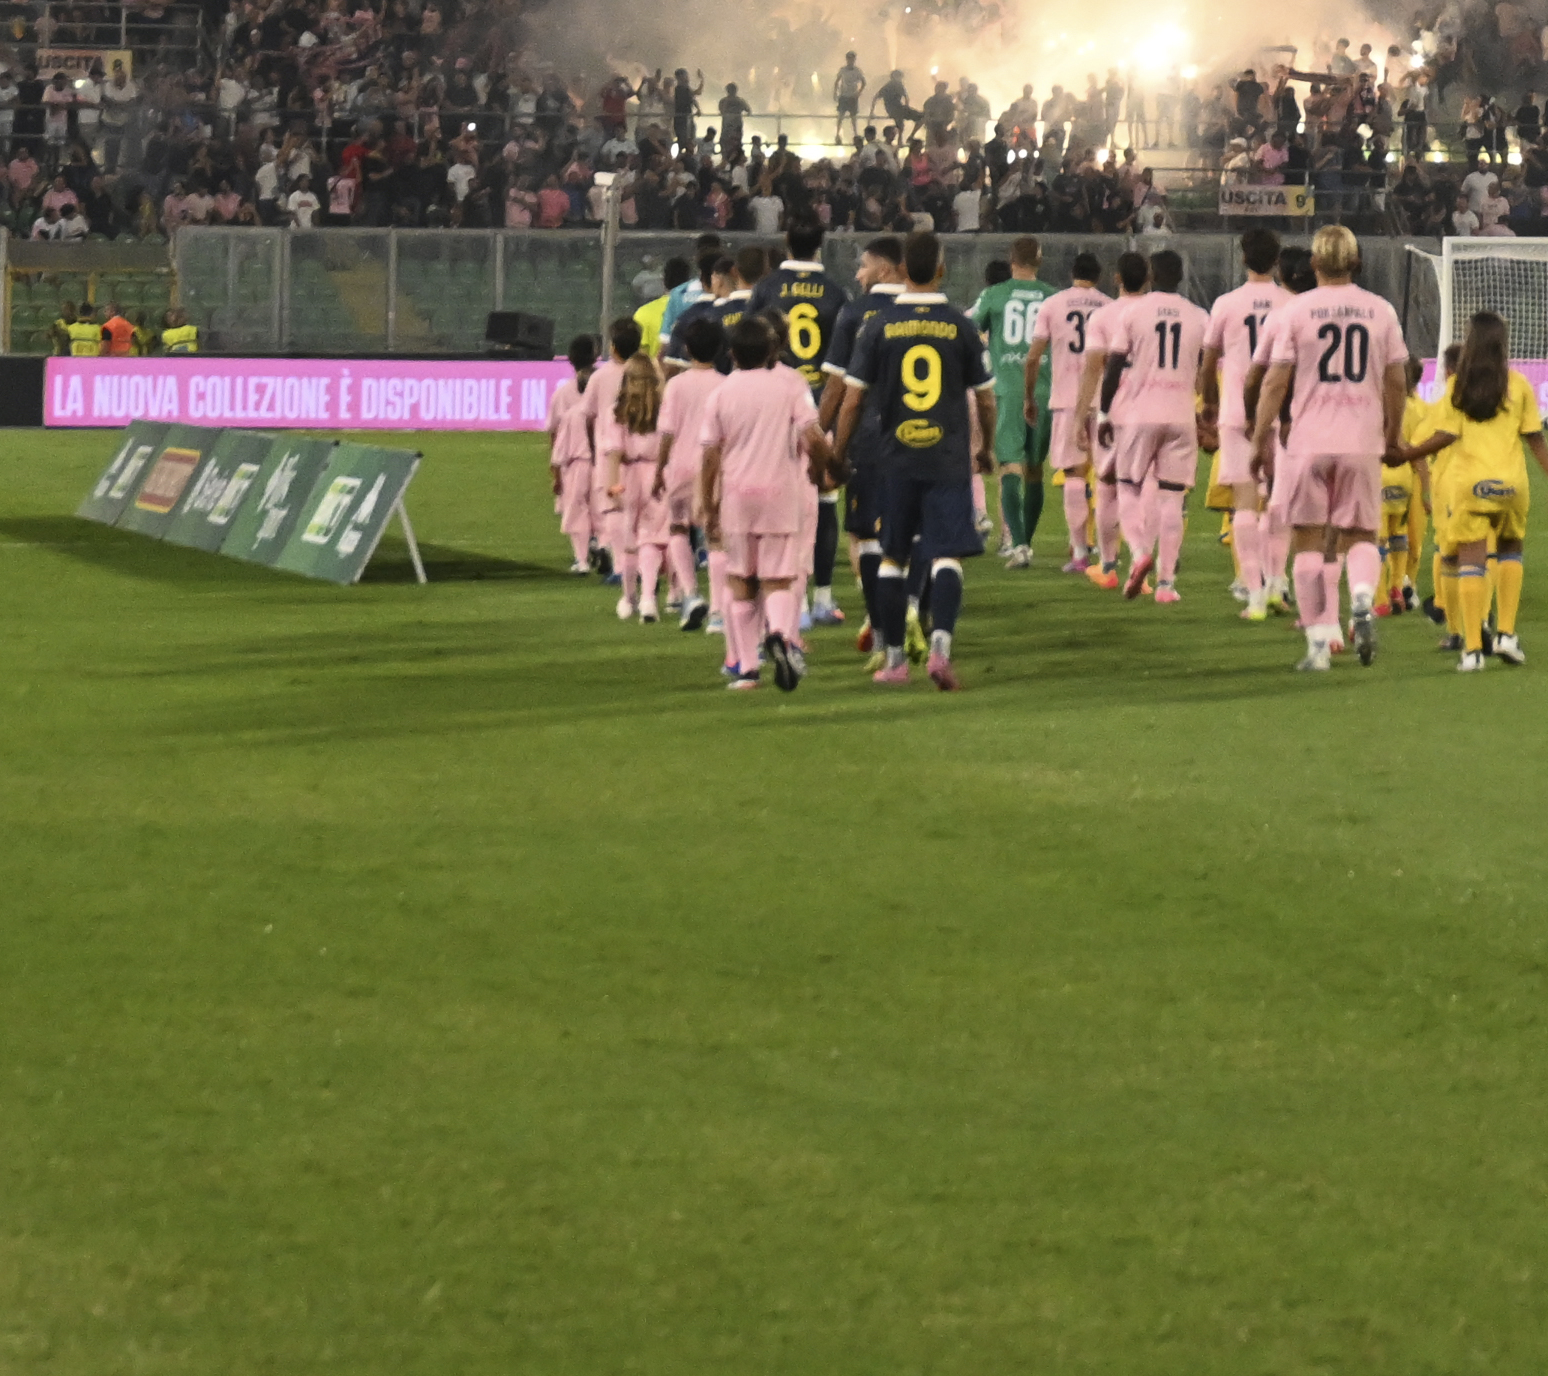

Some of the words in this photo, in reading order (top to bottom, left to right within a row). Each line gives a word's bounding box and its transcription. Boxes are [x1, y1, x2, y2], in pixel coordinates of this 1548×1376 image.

[1221, 190, 1287, 205] USCITA
[788, 302, 822, 360] 6
[884, 319, 958, 341] RAIMONDO
[1066, 310, 1094, 354] 3
[1154, 320, 1183, 370] 11
[1317, 322, 1370, 383] 20
[53, 374, 84, 417] LA
[92, 375, 180, 418] NUOVA
[188, 375, 330, 419] COLLEZIONE
[339, 367, 352, 419] È
[361, 376, 512, 420] DISPONIBILE
[520, 379, 547, 420] IN
[901, 344, 943, 412] 9
